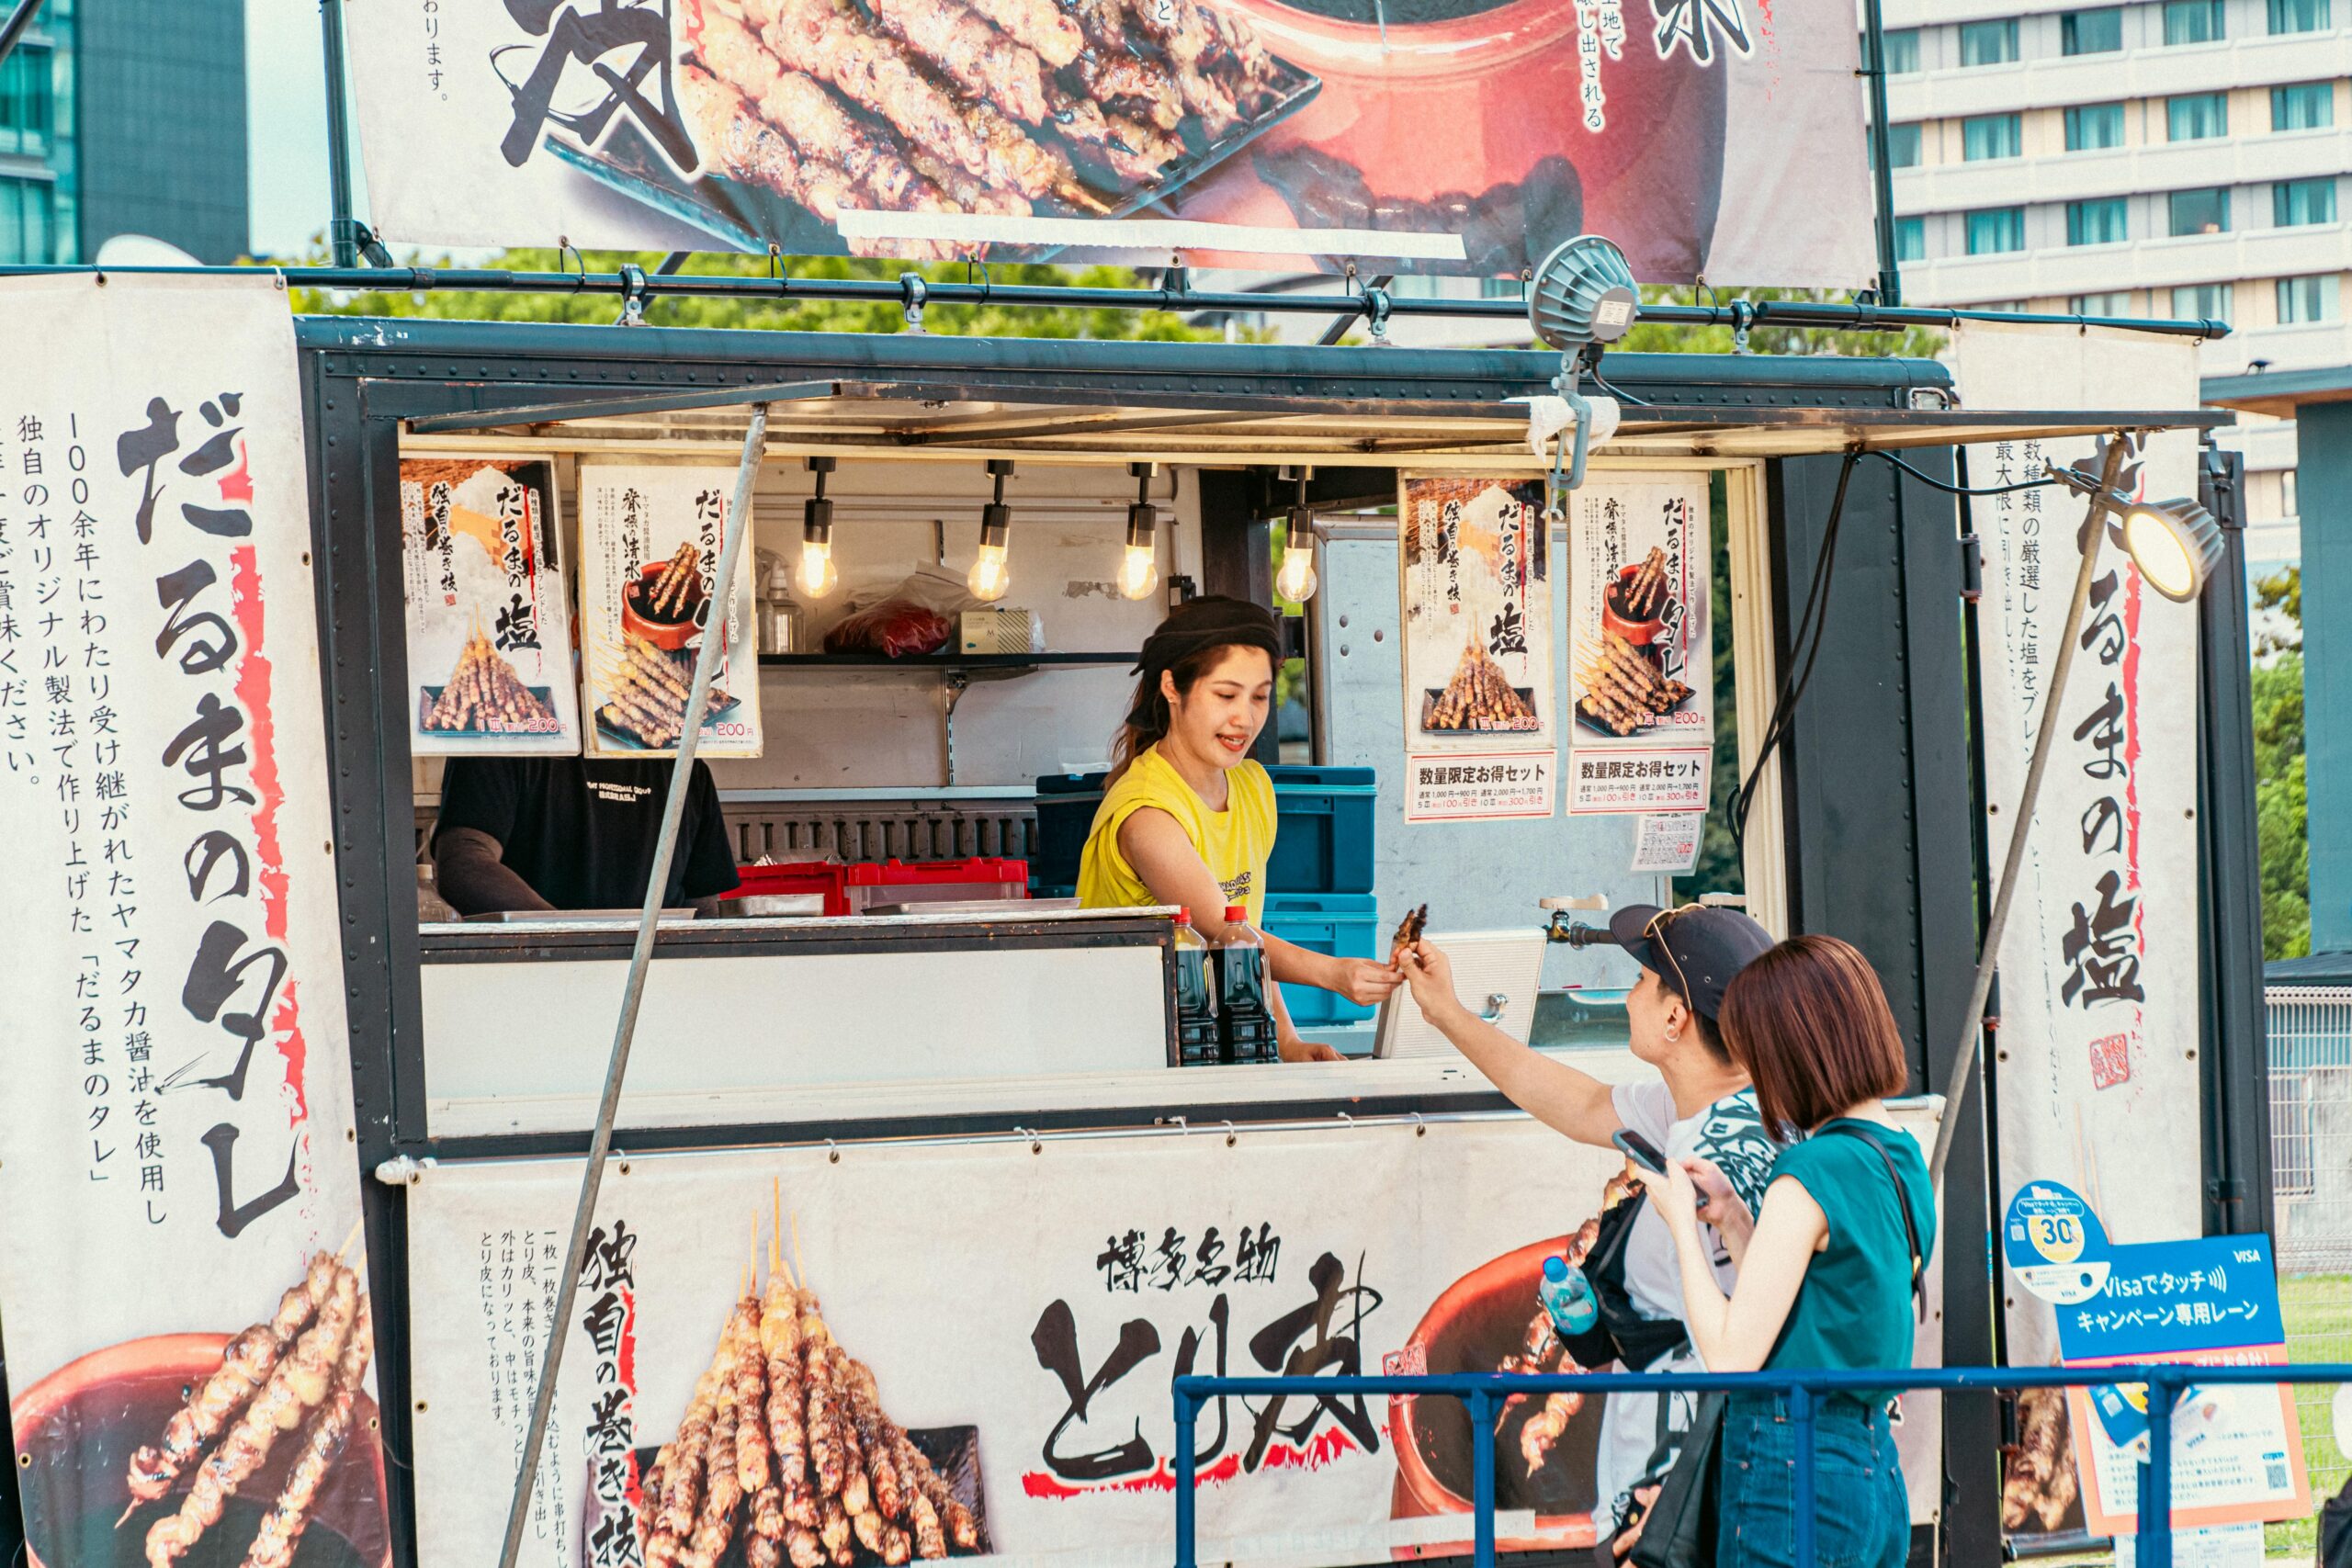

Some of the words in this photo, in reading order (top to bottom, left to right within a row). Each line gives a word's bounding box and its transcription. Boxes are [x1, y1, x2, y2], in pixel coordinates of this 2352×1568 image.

[1601, 0, 1623, 56] 地で
[495, 485, 543, 652] だるまの塩
[1489, 502, 1528, 657] だるまの塩
[1419, 763, 1545, 785] 数量限定お得セット
[1581, 760, 1701, 780] 数量限定お得セット
[117, 392, 301, 1239] だるまのタレ
[1096, 1221, 1282, 1293] 博多名物
[2041, 1218, 2073, 1245] 30
[2233, 1249, 2261, 1264] VISA
[2103, 1270, 2206, 1298] Visaでタッチ
[2076, 1300, 2259, 1334] キャンペーン専用レーン
[1030, 1249, 1384, 1481] とり皮
[579, 1219, 643, 1568] 独自の巻き技
